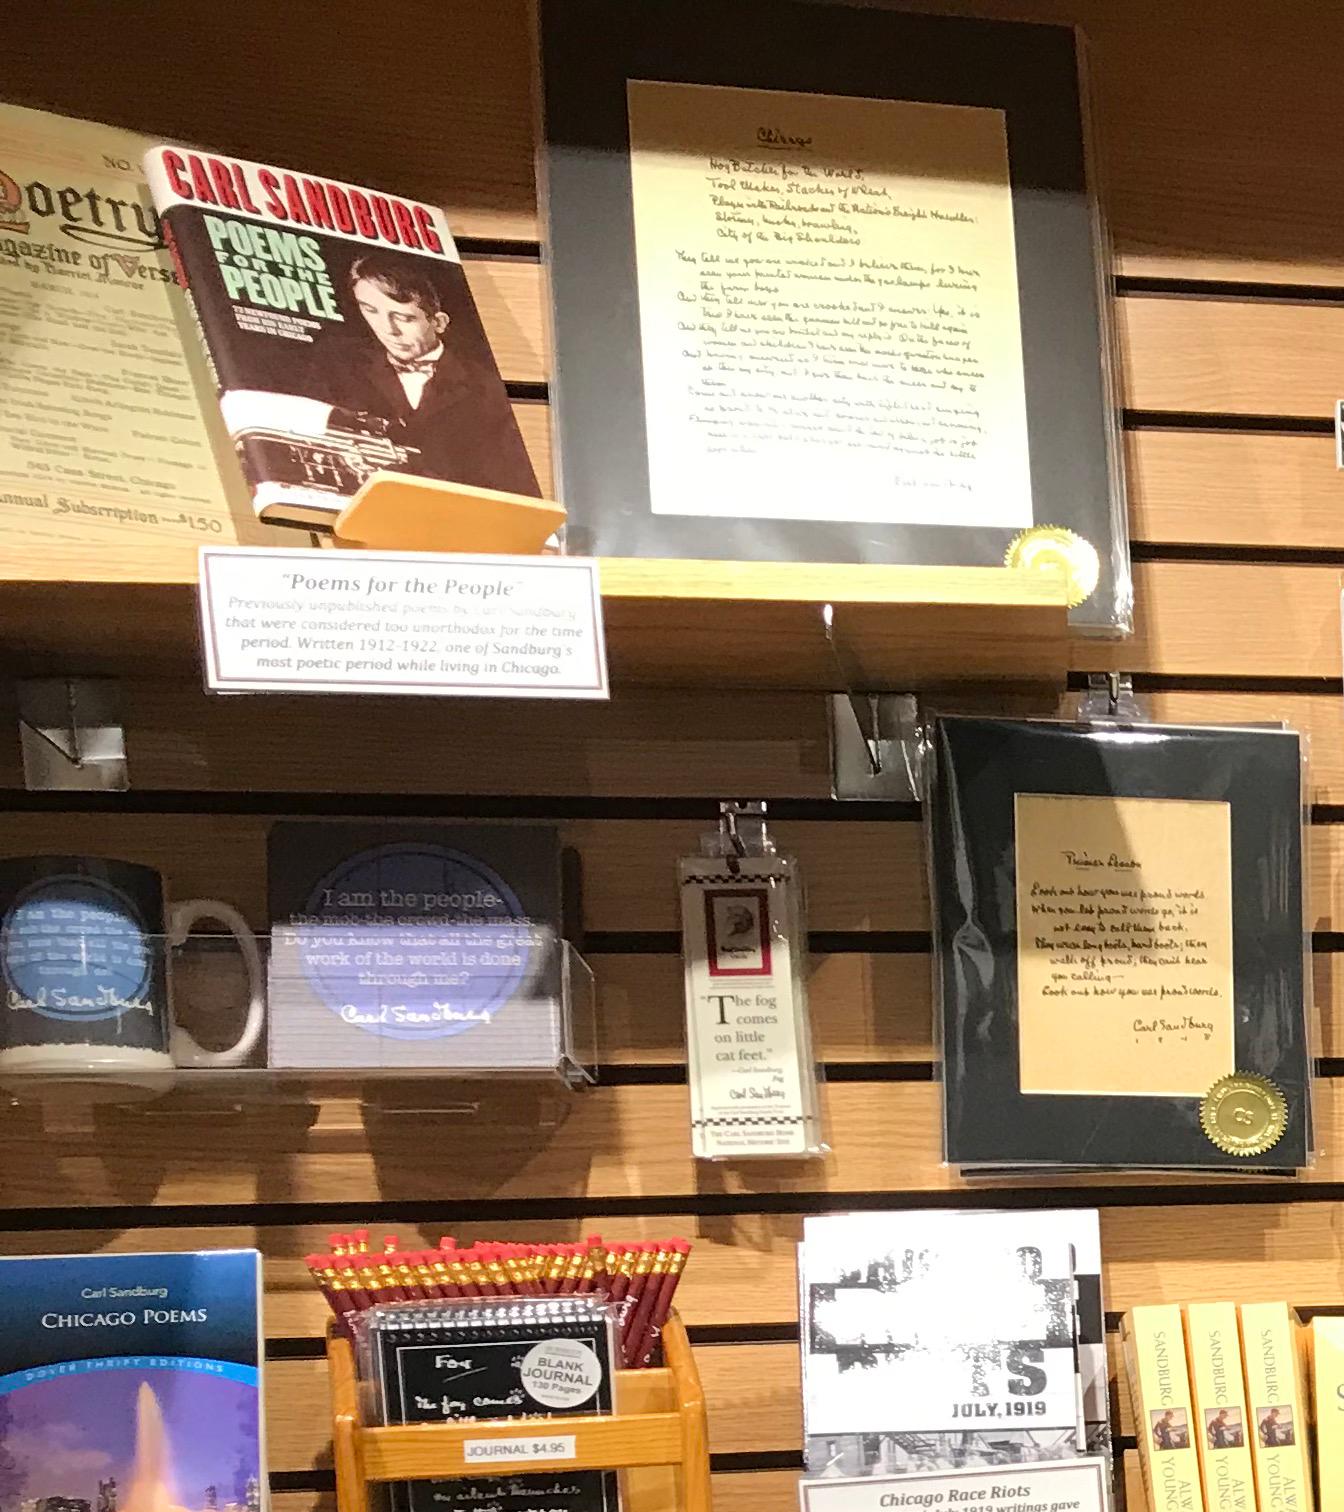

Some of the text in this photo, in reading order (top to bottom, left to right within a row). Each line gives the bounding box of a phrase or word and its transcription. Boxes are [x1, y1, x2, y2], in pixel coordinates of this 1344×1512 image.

[162, 149, 444, 254] CARL SANDBURG
[204, 215, 325, 272] POEMS
[216, 252, 332, 287] FOR THE
[219, 266, 344, 322] PEOPLE
[756, 994, 777, 1011] fog
[736, 1013, 778, 1025] comes
[714, 1030, 766, 1044] on little
[715, 1051, 737, 1062] cat
[82, 1284, 168, 1301] Carl Sandburg
[42, 1307, 207, 1329] CHICAGO POEMS
[537, 1356, 584, 1372] BLANK
[523, 1370, 592, 1388] JOURNAL
[466, 1442, 565, 1458] JOURNAL $4.95
[880, 1485, 1031, 1509] Chicago Race Riots
